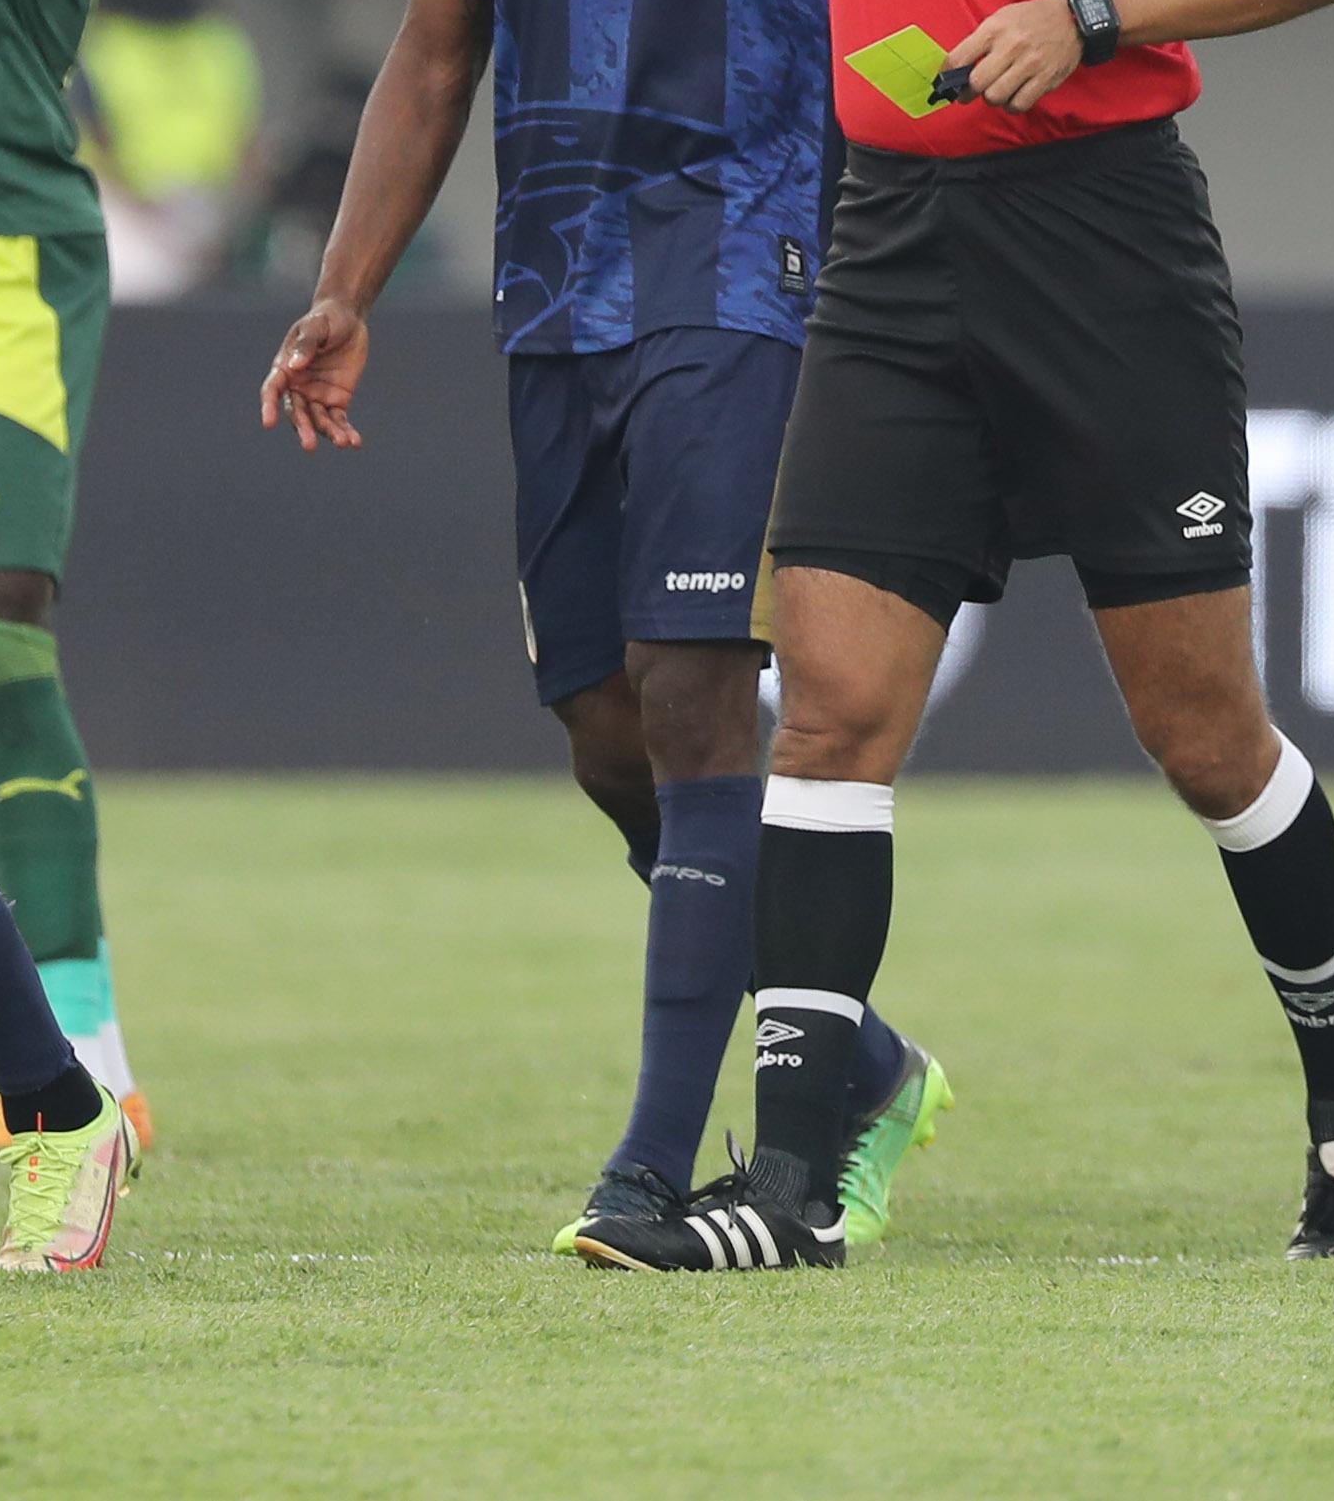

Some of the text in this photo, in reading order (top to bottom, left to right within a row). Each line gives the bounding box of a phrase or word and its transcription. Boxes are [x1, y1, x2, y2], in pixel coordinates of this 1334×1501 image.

[1183, 521, 1224, 539] umbro
[665, 571, 746, 594] tempo
[650, 864, 726, 887] mpo
[754, 1050, 804, 1073] bro
